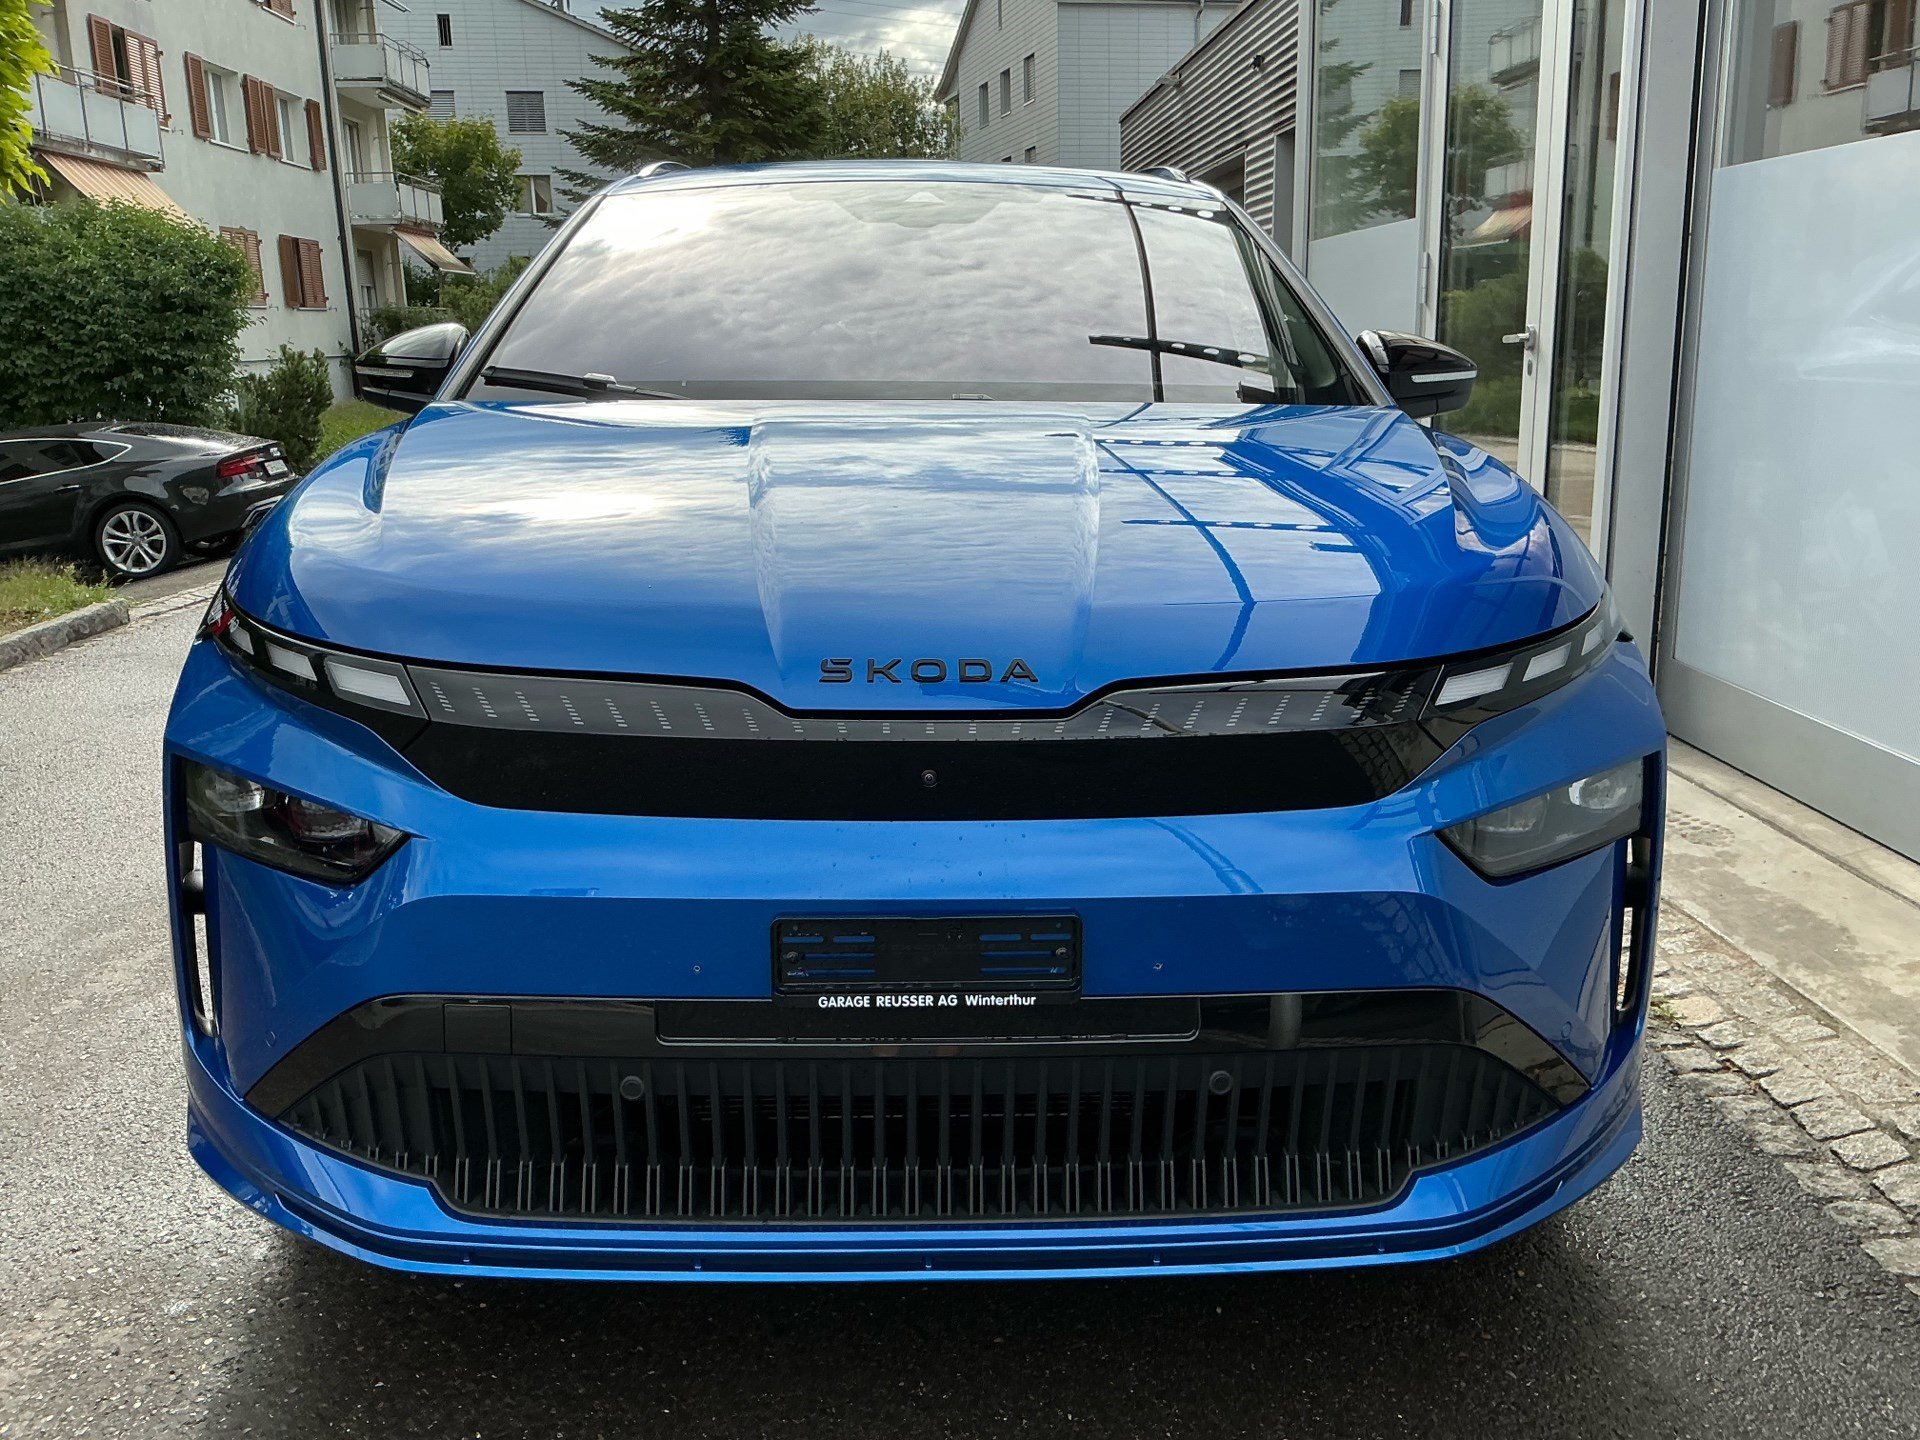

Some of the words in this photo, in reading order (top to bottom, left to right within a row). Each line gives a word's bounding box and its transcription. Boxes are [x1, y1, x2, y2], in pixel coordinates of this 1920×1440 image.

[817, 995, 871, 1009] GARAGE
[876, 994, 934, 1008] REUSSER
[937, 994, 958, 1007] AG
[964, 993, 1037, 1007] Winterthur
